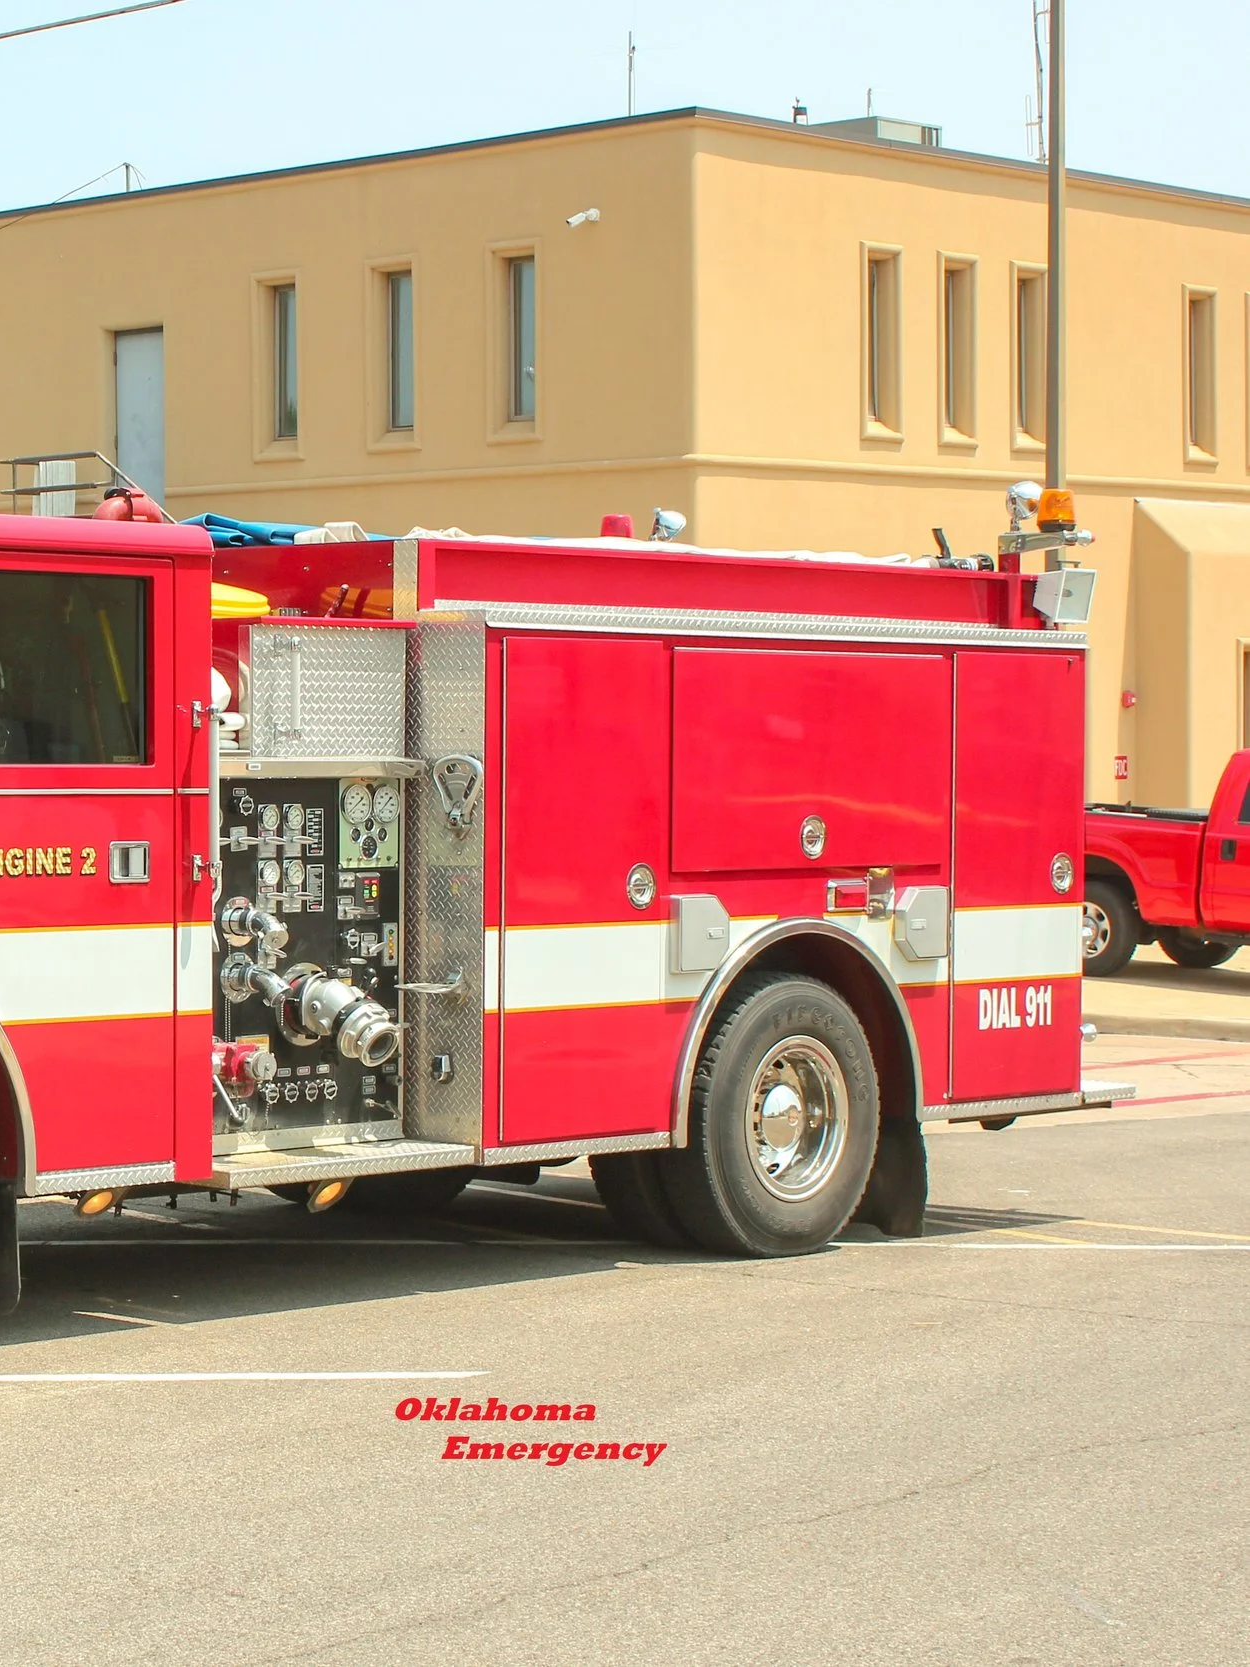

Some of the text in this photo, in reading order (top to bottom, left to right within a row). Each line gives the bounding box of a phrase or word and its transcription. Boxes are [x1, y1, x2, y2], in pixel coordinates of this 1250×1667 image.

[80, 847, 96, 876] 2
[979, 985, 1052, 1030] DIAL 911
